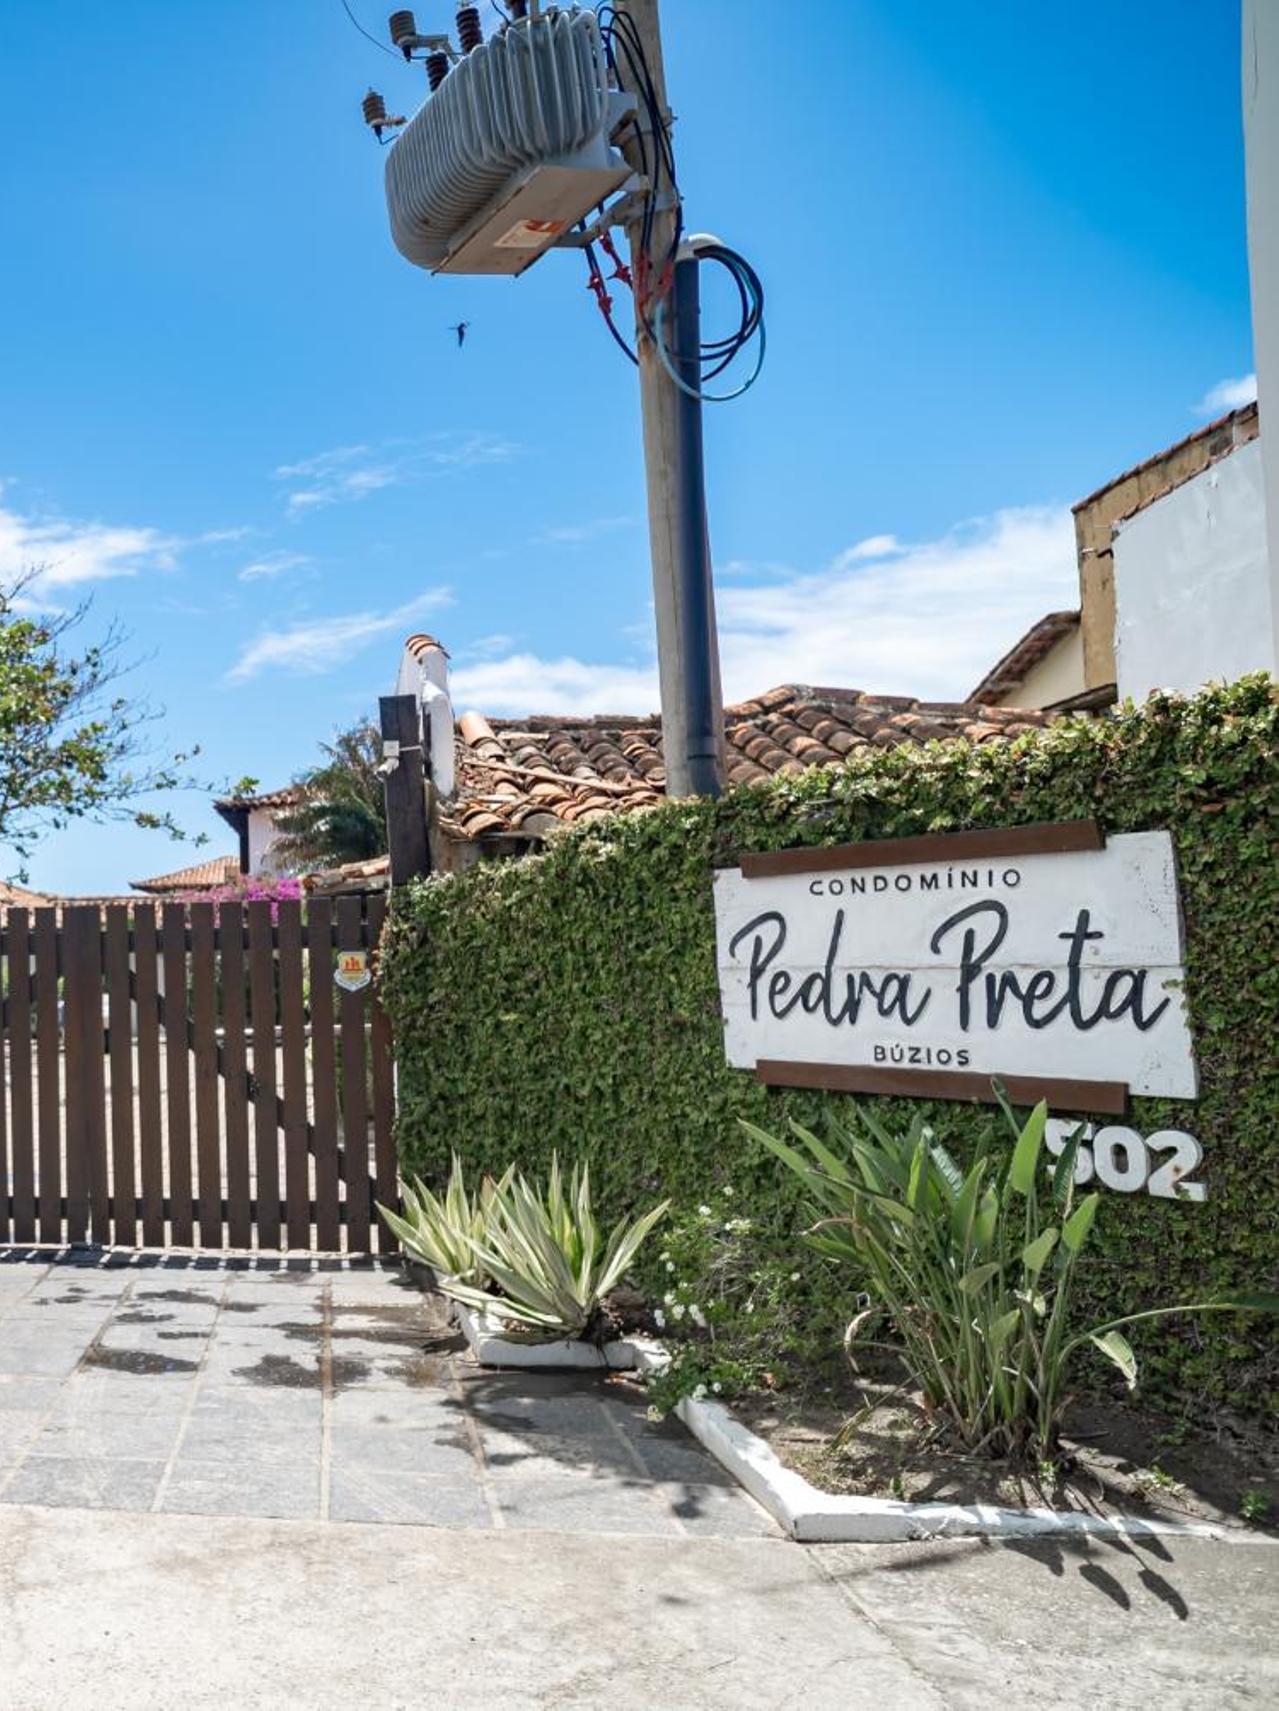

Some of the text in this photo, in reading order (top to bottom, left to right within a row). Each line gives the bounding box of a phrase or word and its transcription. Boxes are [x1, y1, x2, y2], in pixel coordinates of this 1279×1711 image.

[809, 867, 1022, 897] CONDOMÍNIO
[728, 899, 1170, 1032] Pedra Preta
[873, 1044, 971, 1067] BÚZIOS
[1045, 1118, 1208, 1202] 502
